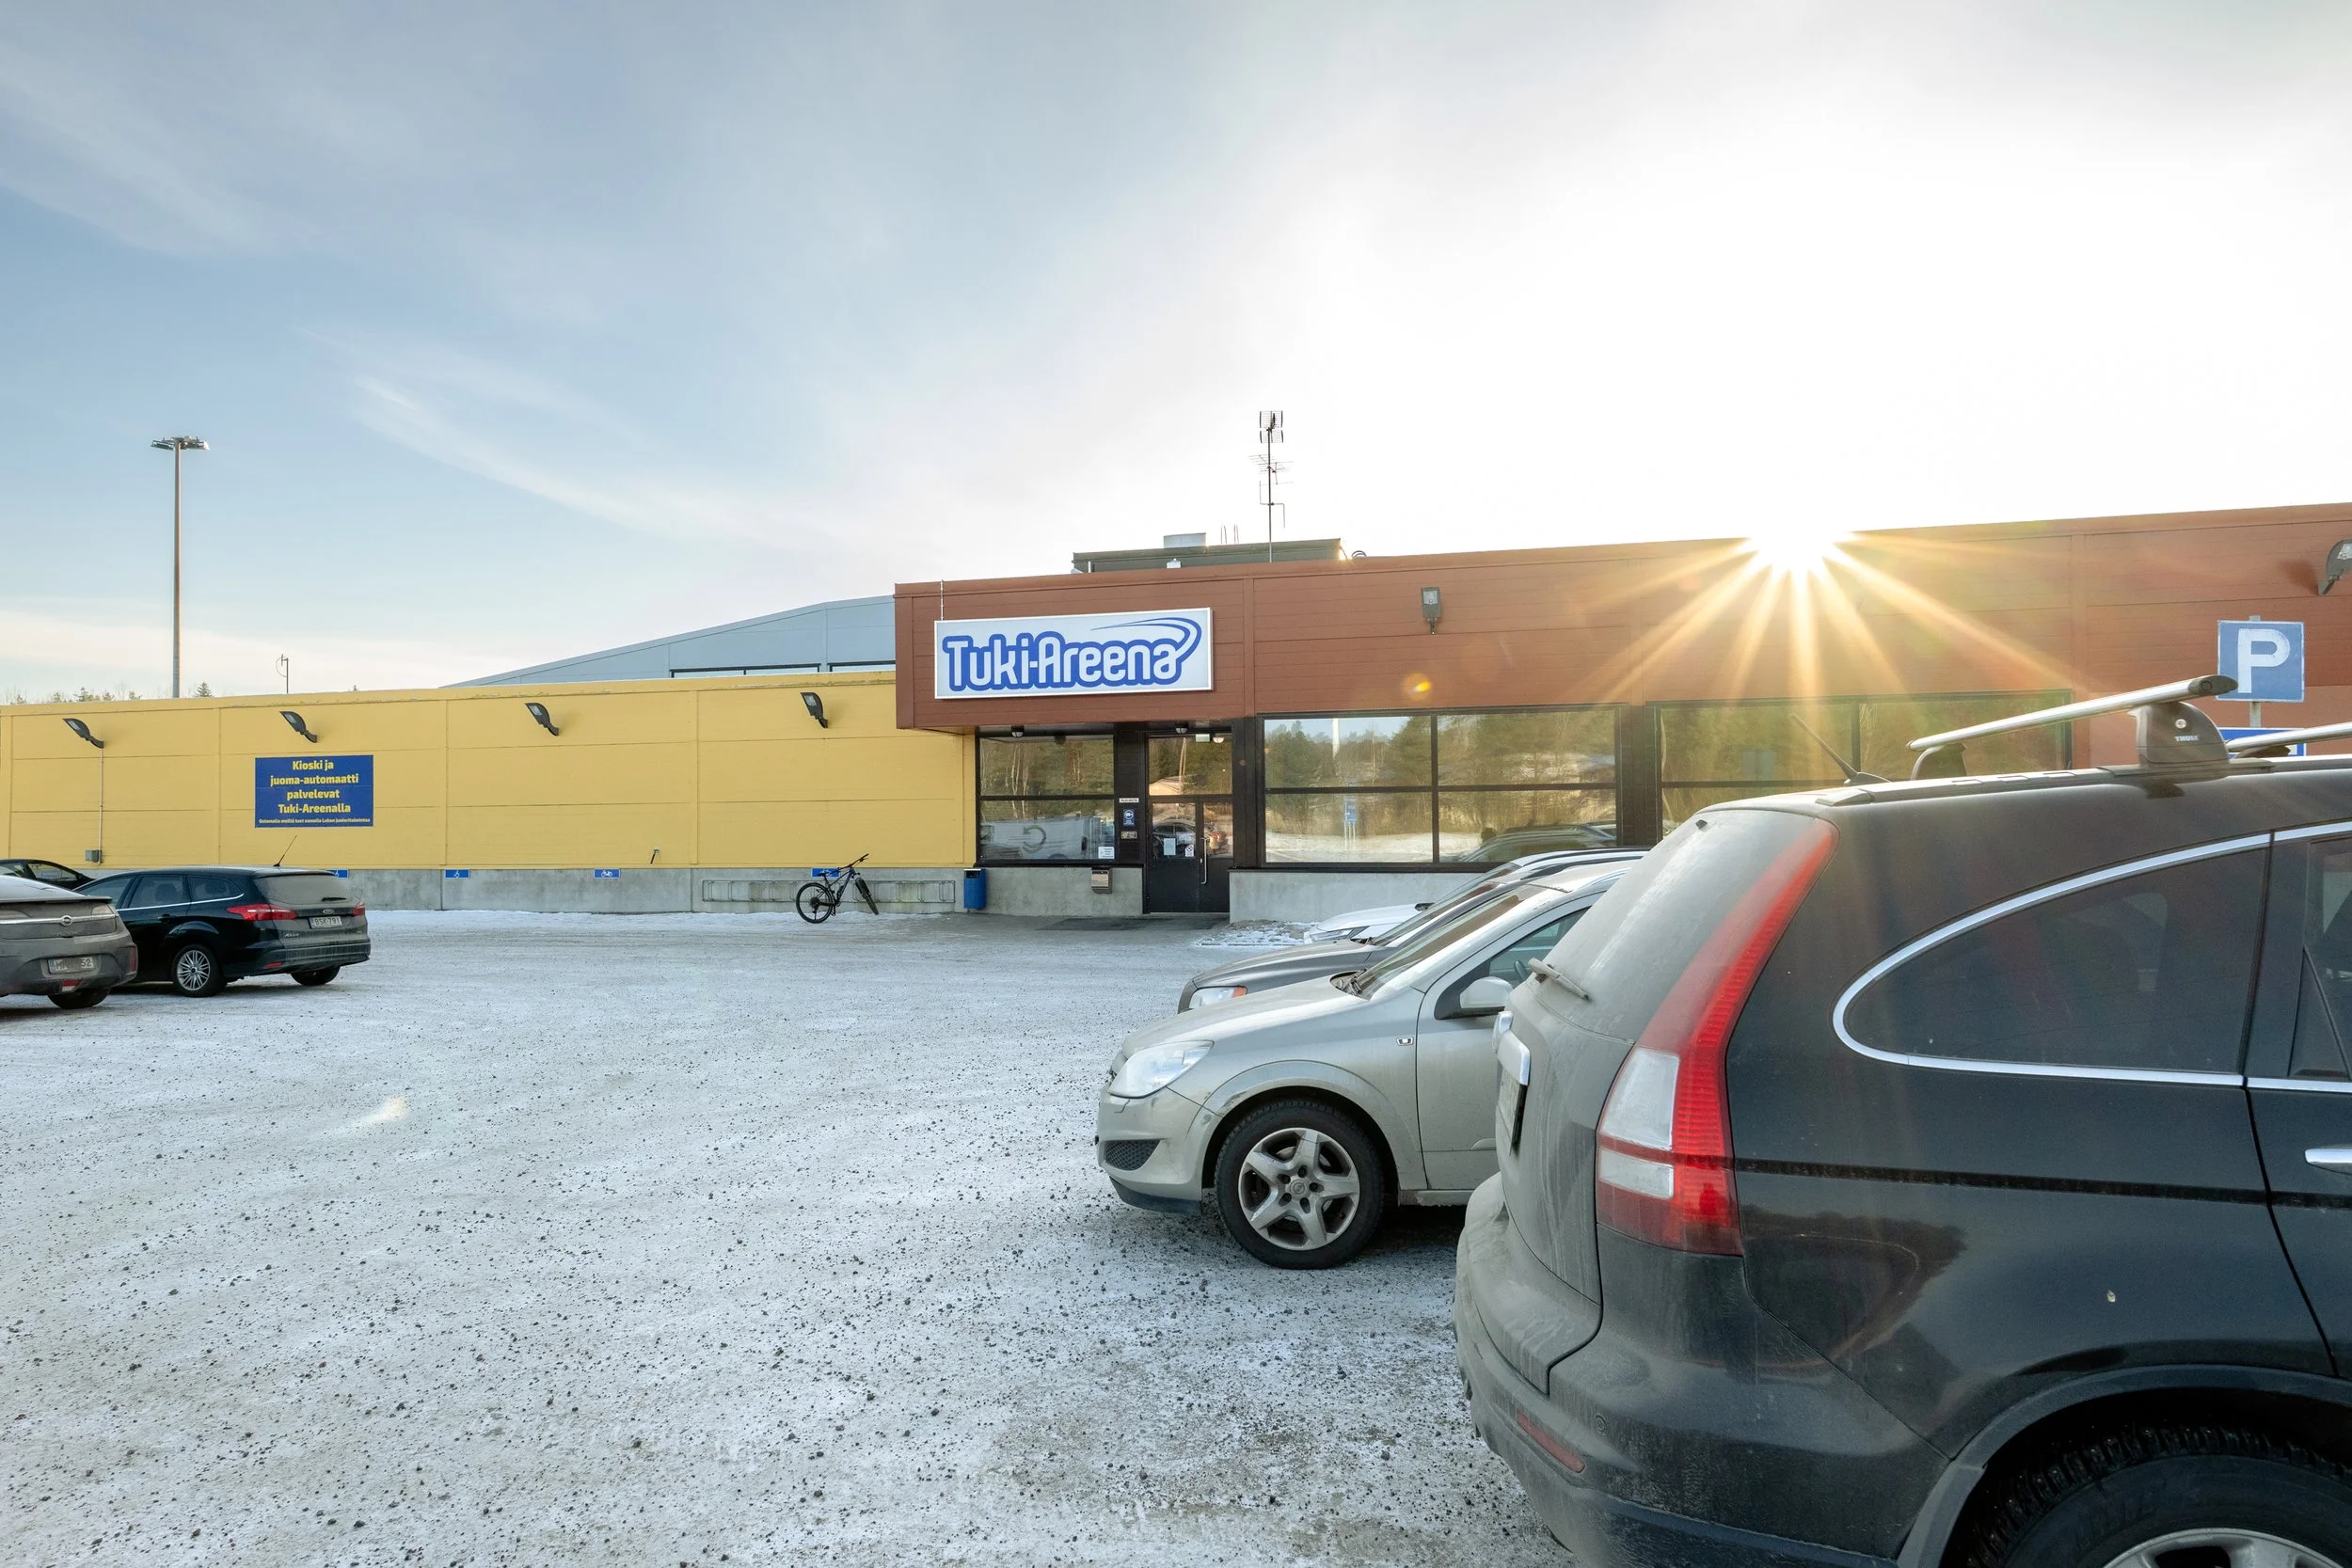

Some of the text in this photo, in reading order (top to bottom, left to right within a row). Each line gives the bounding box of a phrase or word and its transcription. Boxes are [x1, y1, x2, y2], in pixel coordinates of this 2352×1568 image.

[943, 631, 1181, 691] Tuki-Areena
[2237, 628, 2290, 693] P
[293, 760, 334, 771] Kioski ja
[270, 773, 358, 786] juoma-automaatti
[287, 789, 340, 800] palvelevat
[278, 803, 351, 813] Tuki-Areenalla
[314, 917, 342, 926] BSK-791
